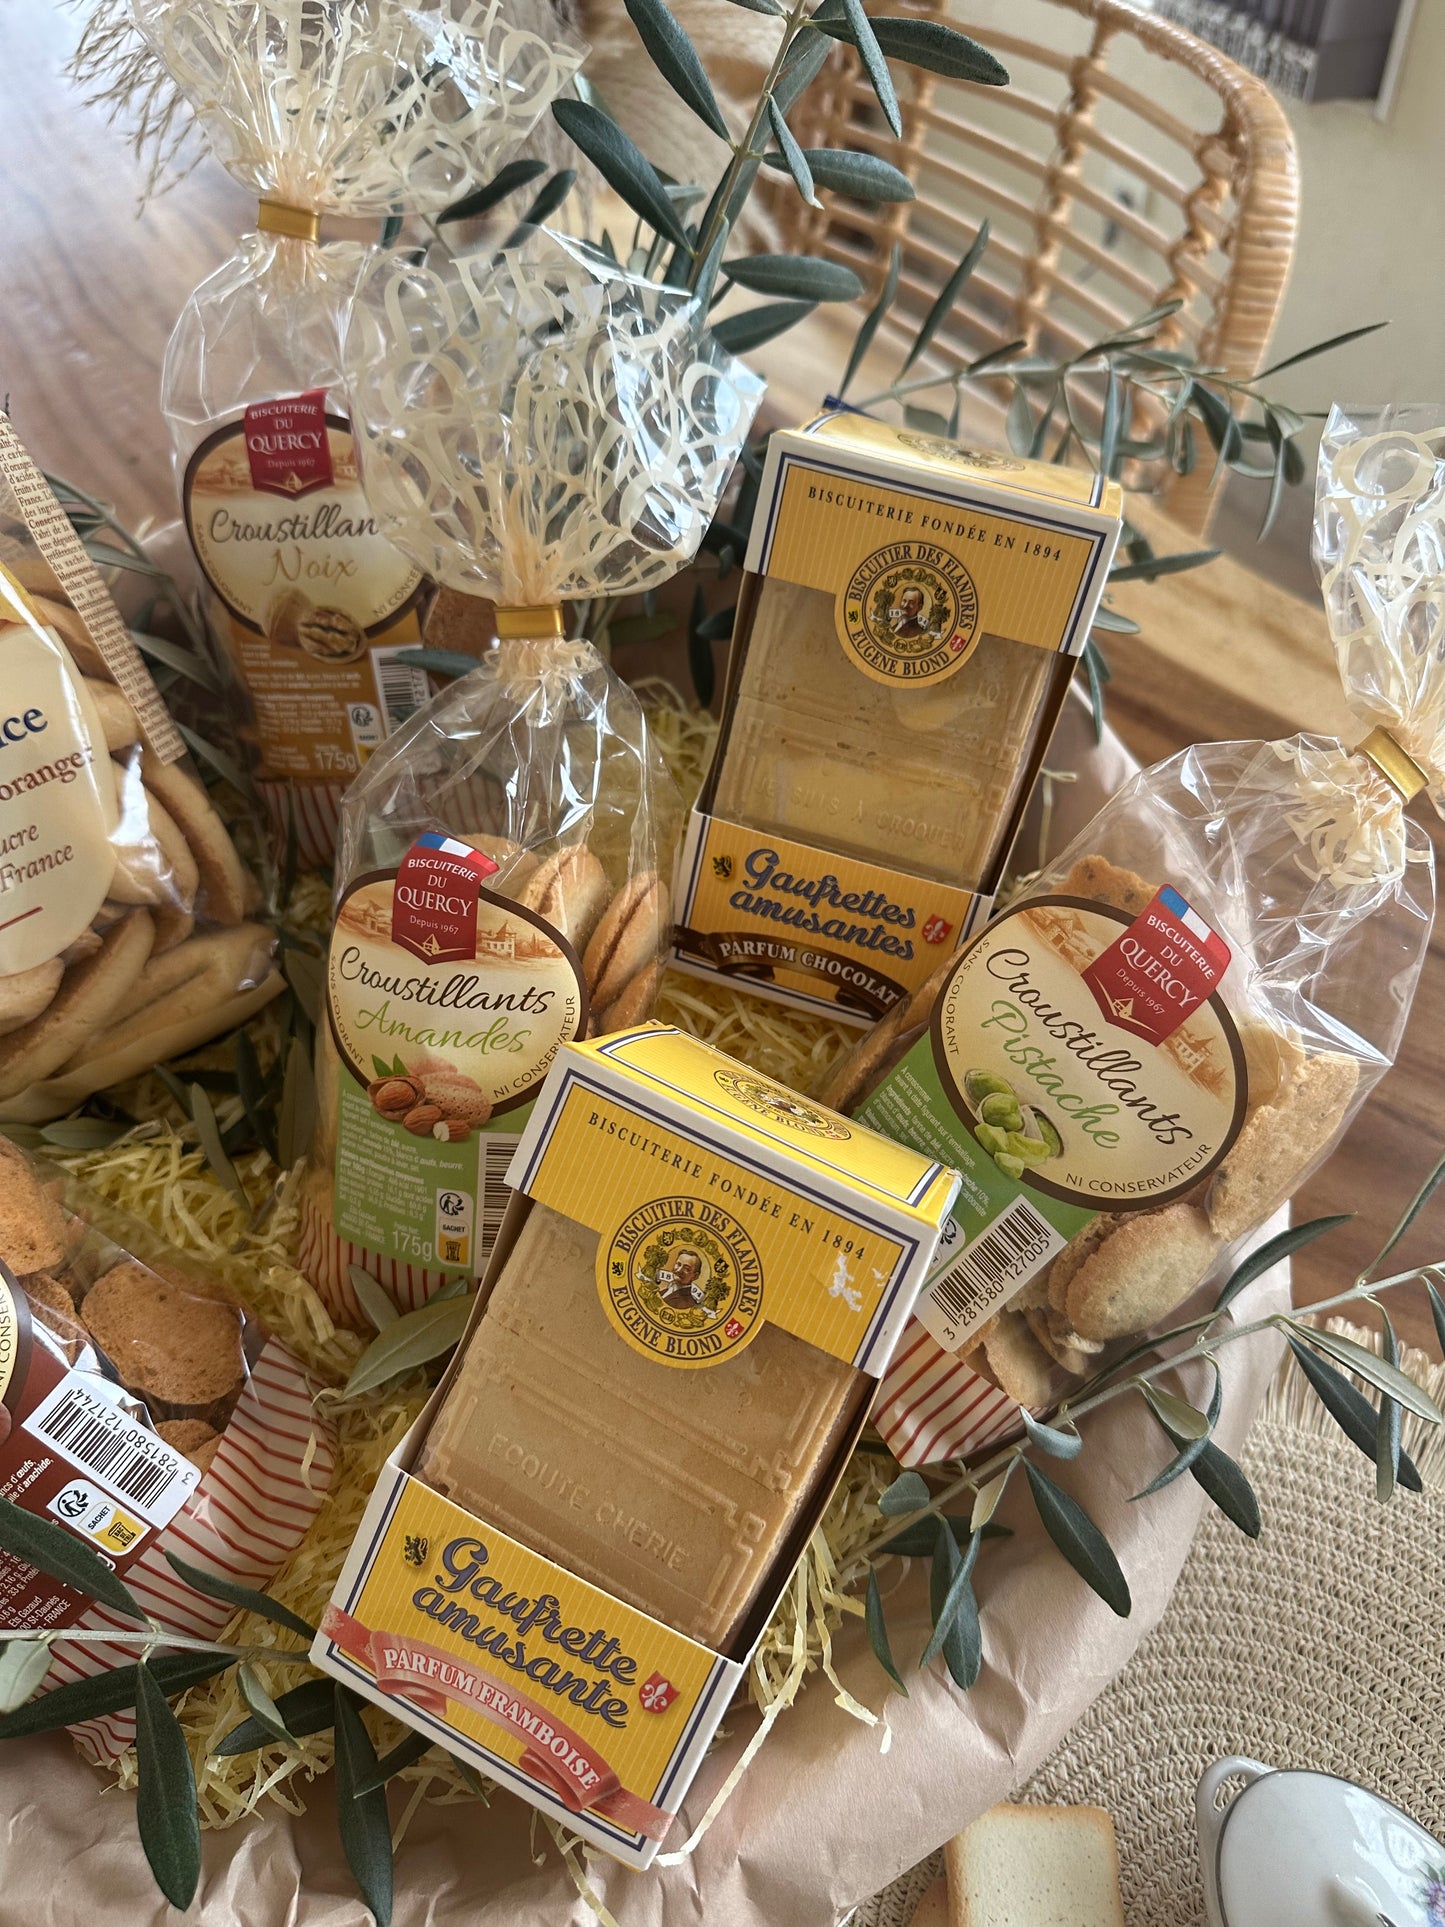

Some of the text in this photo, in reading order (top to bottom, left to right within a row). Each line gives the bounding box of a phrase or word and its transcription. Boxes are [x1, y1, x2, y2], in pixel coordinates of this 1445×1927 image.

[250, 404, 318, 420] BISCUITERIE
[274, 419, 293, 430] DU
[249, 433, 321, 455] QUERCY
[210, 504, 382, 543] Croustillan
[808, 486, 1063, 562] BISCUITERIE FONDÉE EN 1894
[262, 546, 358, 586] Noix
[388, 565, 422, 607] CONSE
[849, 545, 975, 630] BISCUITIER DES FLANDRES
[851, 629, 950, 677] EUGENE BLOND
[0, 708, 48, 748] ce
[314, 752, 358, 773] 175g
[0, 843, 74, 893] France
[408, 858, 478, 882] BISCUITERIE
[428, 874, 448, 889] DU
[742, 848, 916, 930] Gaufrettes
[397, 886, 473, 918] QUERCY
[409, 915, 459, 934] Depuis 1967
[729, 890, 915, 960] amusantes
[1146, 914, 1215, 981] BISCUITERIE
[1160, 945, 1183, 967] DU
[340, 946, 555, 1014] Croustillants
[719, 941, 900, 1005] PARFUM CHOCOLAT
[1115, 967, 1165, 1016] Depuis 1967
[1118, 937, 1198, 1009] QUERCY
[943, 939, 989, 1056] SANS COLORANT
[333, 994, 366, 1066] COLORANT
[354, 1000, 532, 1055] Amandes
[493, 995, 576, 1099] NI CONSERVATEUR
[986, 948, 1193, 1145] Croustillants
[981, 1000, 1120, 1151] Pistache
[588, 1111, 868, 1260] BISCUITERIE FONDÉE EN 1894
[1065, 1143, 1212, 1193] NI CONSERVATEUR
[393, 1230, 433, 1262] 175g
[614, 1200, 761, 1316] BISCUITIER DES FLANDRES
[1005, 1235, 1050, 1281] 127005
[661, 1272, 671, 1281] 18
[612, 1285, 723, 1356] EUGENE BLOND
[958, 1280, 1004, 1327] 281580
[943, 1327, 956, 1341] 3
[73, 1387, 124, 1431] 121744
[11, 1459, 37, 1483] d'œufs,
[126, 1429, 178, 1473] 281580
[18, 1456, 54, 1493] d'arachide,
[182, 1471, 194, 1485] 3
[88, 1505, 111, 1530] SACHET
[8, 1595, 43, 1629] Ets Gazaud
[27, 1594, 60, 1626] St-Daunès
[44, 1598, 71, 1625] FRANCE
[435, 1536, 639, 1686] Gaufrette
[411, 1587, 630, 1729] amusante
[383, 1647, 603, 1790] PARFUM FRAMBOISE
